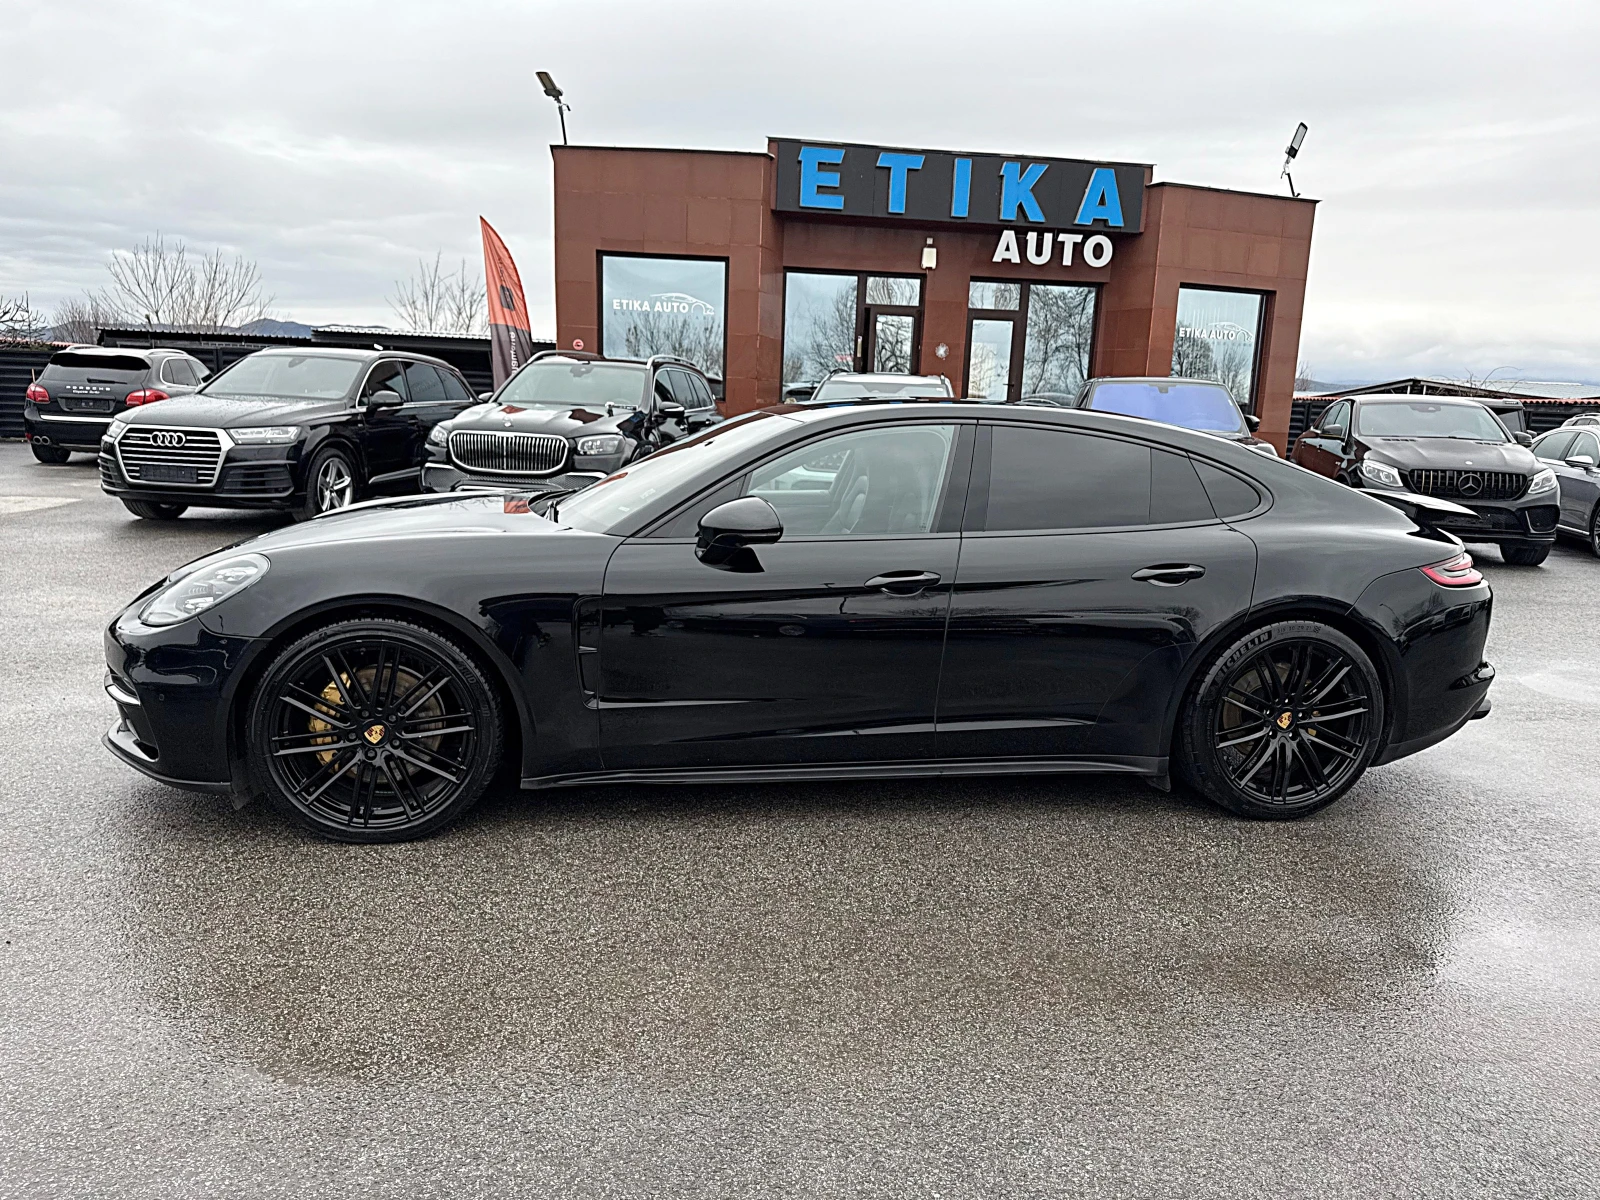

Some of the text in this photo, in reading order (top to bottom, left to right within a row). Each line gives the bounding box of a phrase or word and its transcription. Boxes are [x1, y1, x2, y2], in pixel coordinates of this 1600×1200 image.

[798, 146, 1125, 228] ETIKA
[992, 230, 1113, 268] AUTO
[612, 299, 689, 314] ETIKA AUTO
[1178, 327, 1236, 341] ETIKA AUTO
[1213, 631, 1271, 684] MICHELIN
